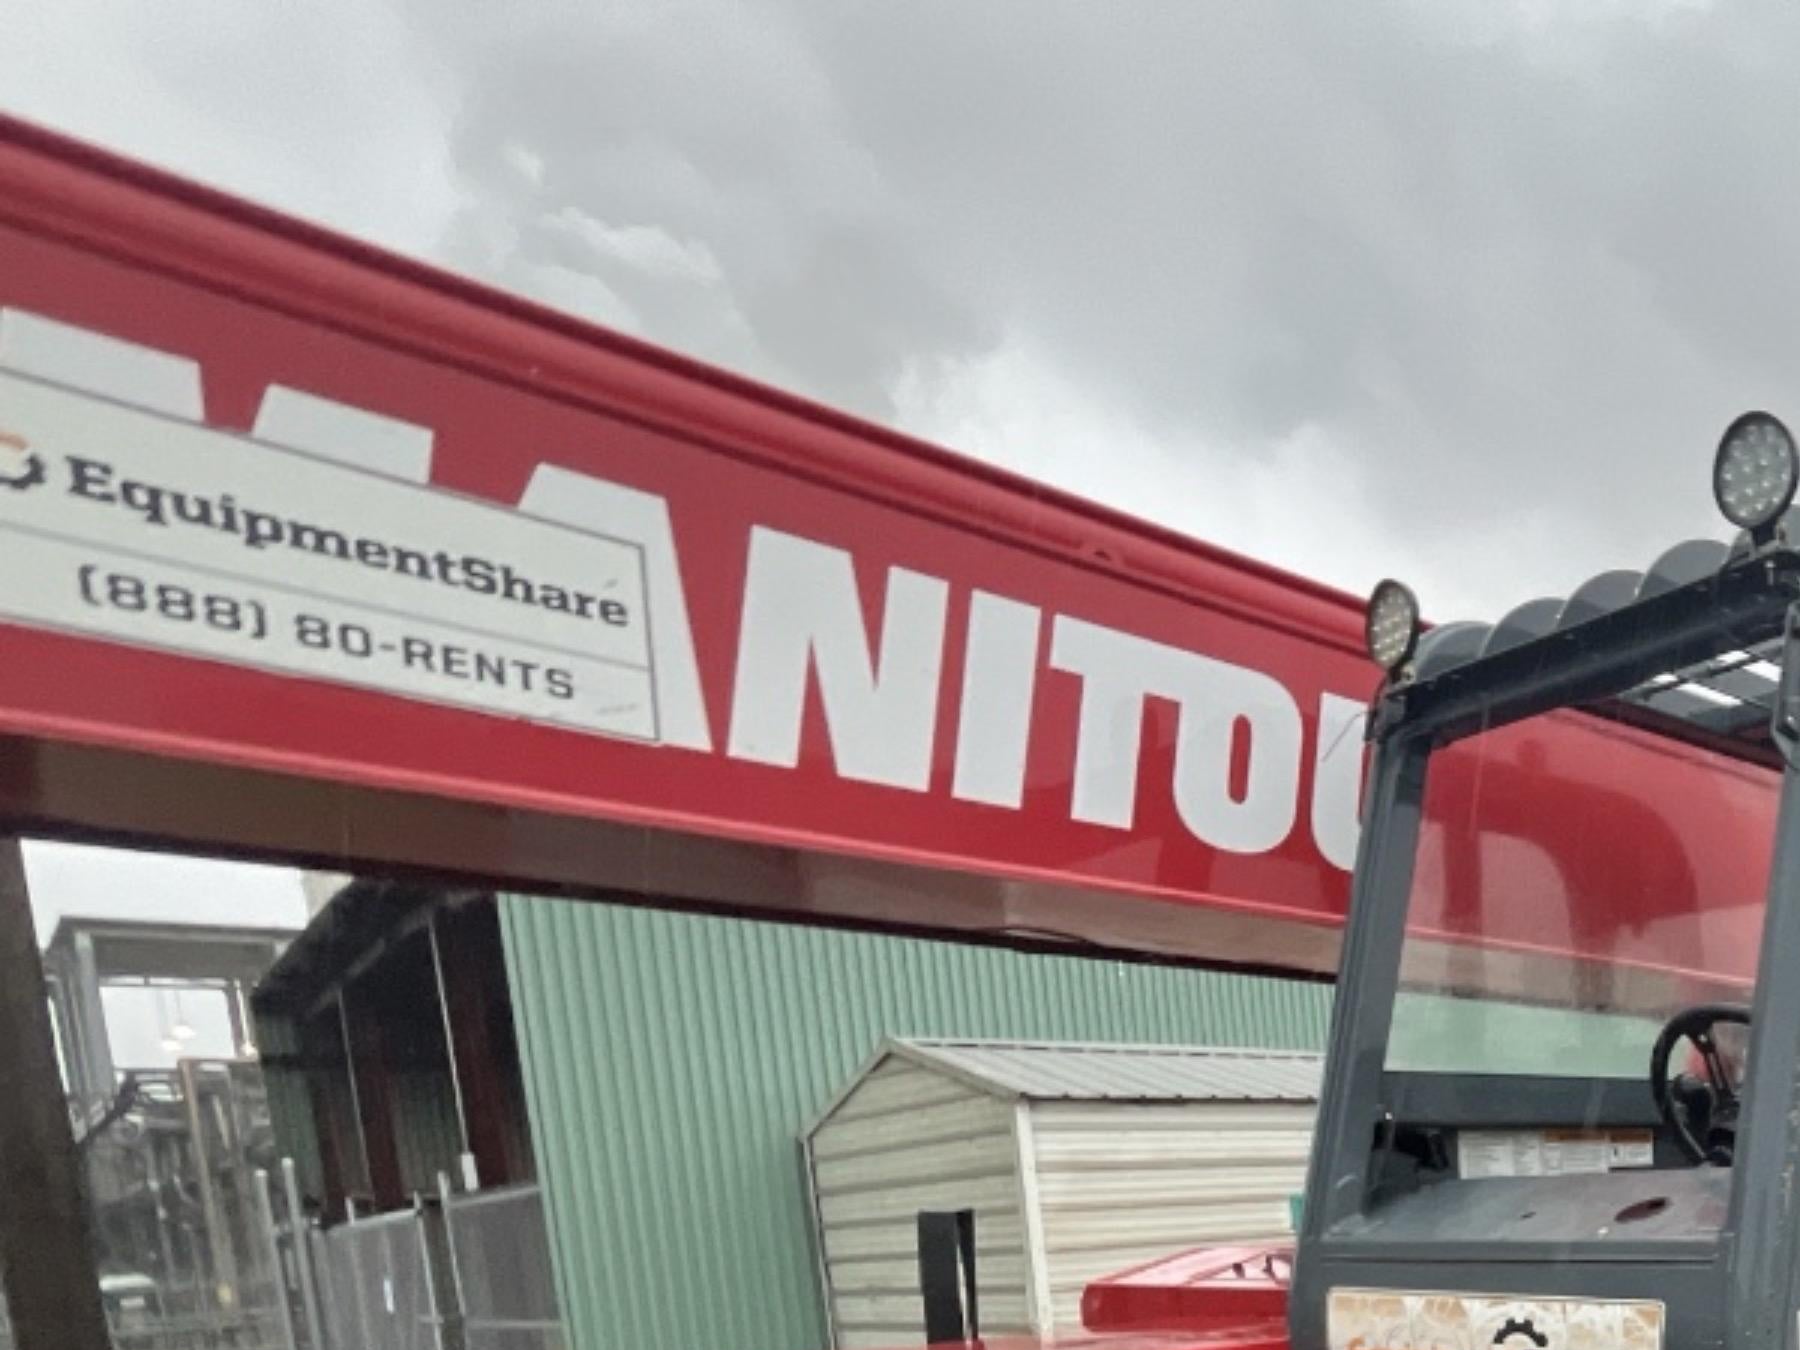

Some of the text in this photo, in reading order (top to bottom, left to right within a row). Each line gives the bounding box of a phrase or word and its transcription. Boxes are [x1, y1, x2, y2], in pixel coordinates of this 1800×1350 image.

[63, 454, 630, 628] EquipmentShare
[77, 563, 576, 700] (888) 80-RENTS
